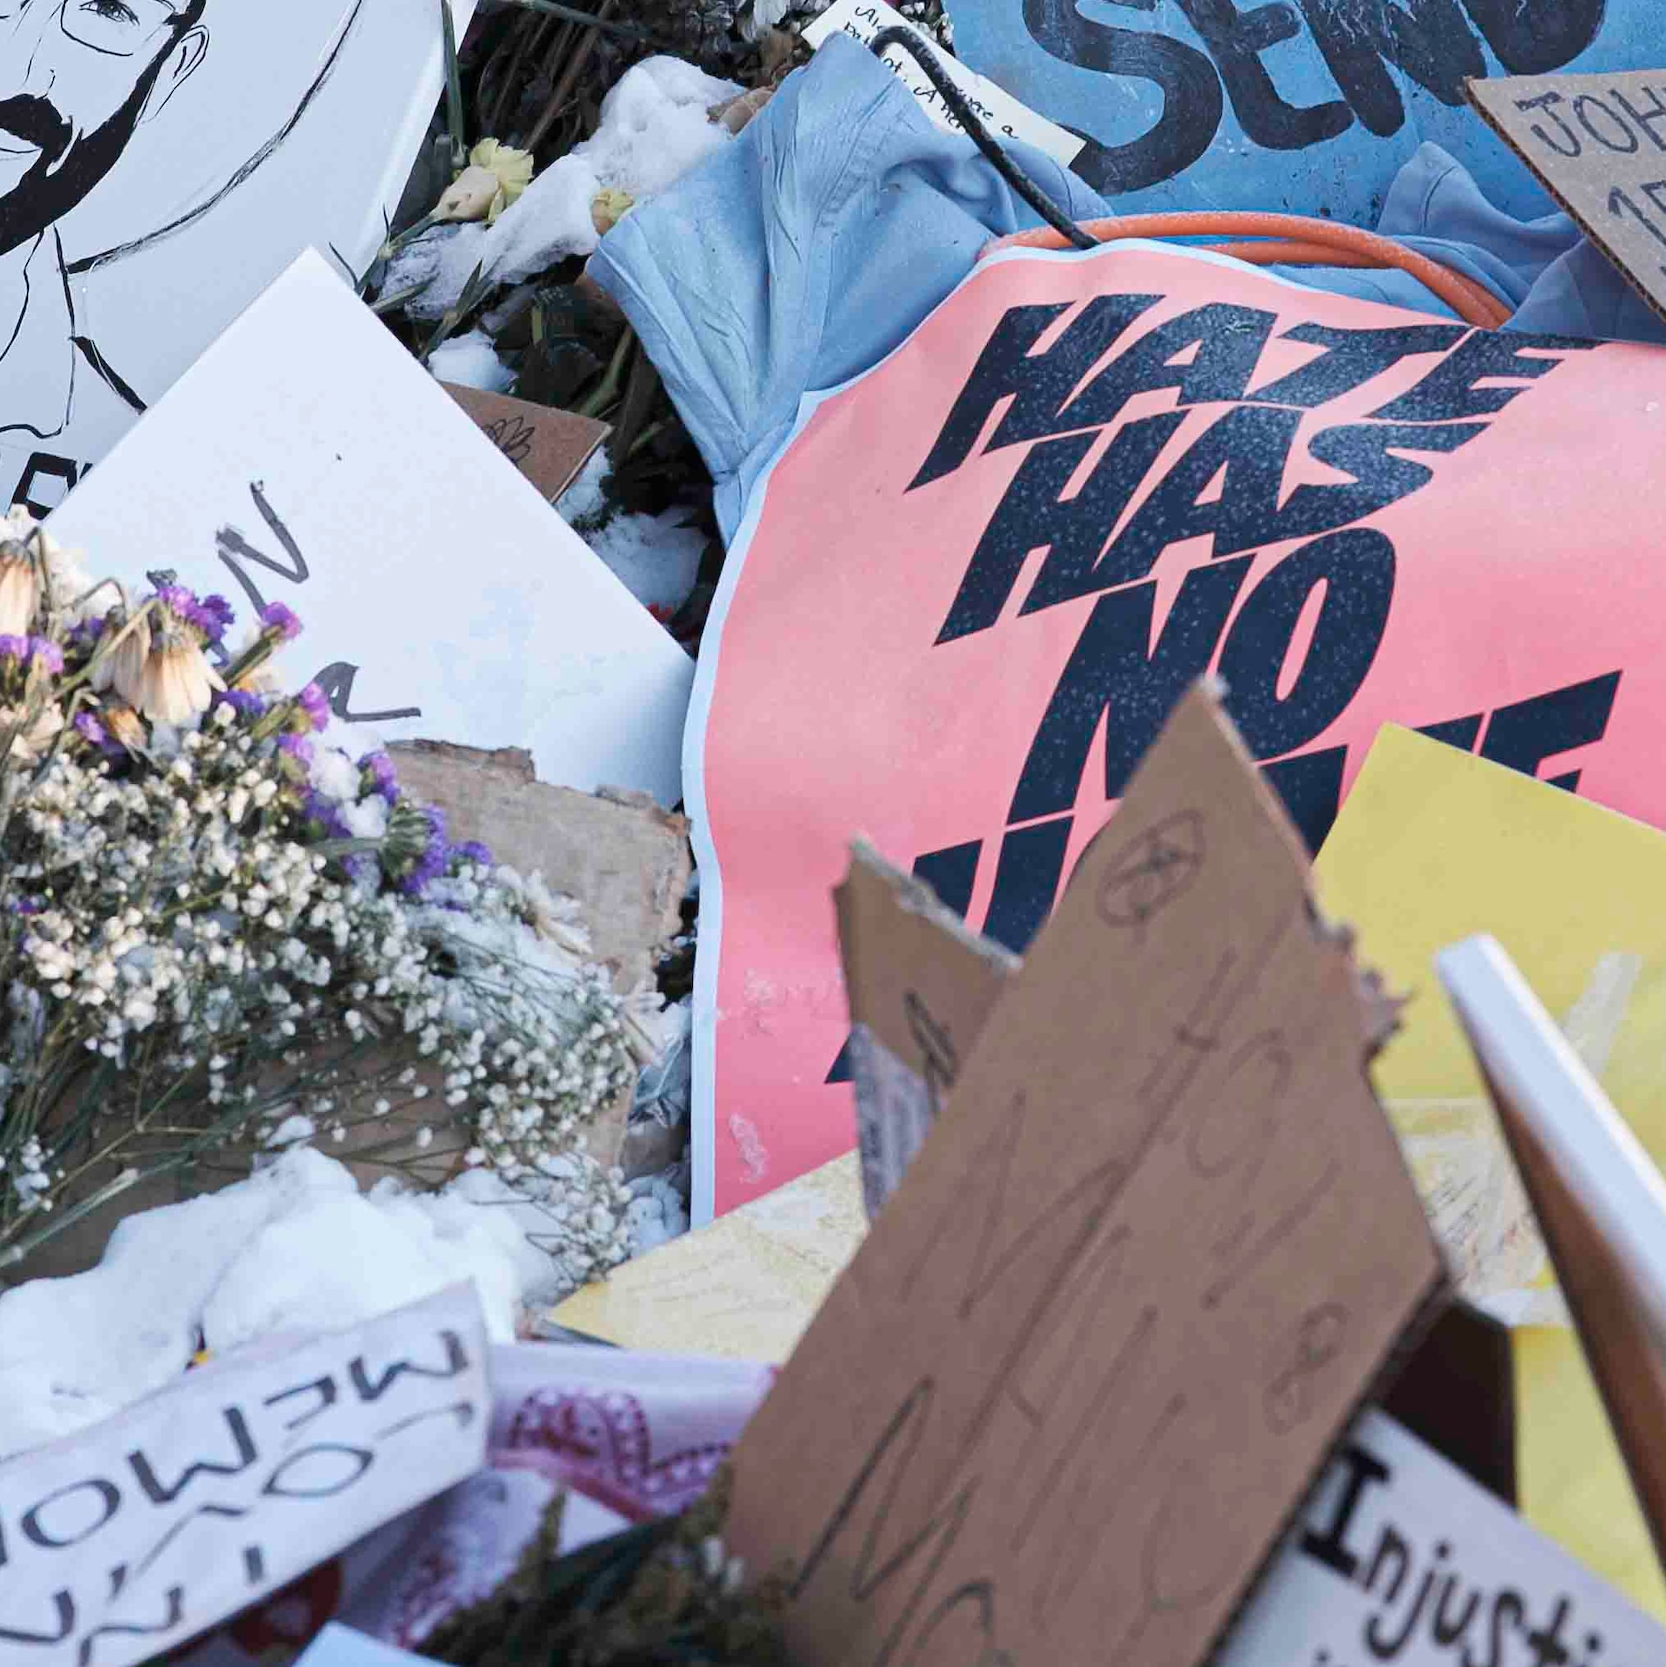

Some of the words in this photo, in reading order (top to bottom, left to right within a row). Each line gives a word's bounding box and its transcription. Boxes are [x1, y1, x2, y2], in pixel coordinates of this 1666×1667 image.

[903, 292, 1609, 497] HATE
[931, 403, 1493, 648] HAS
[1006, 525, 1399, 824] NO
[1296, 1438, 1605, 1667] Injust
